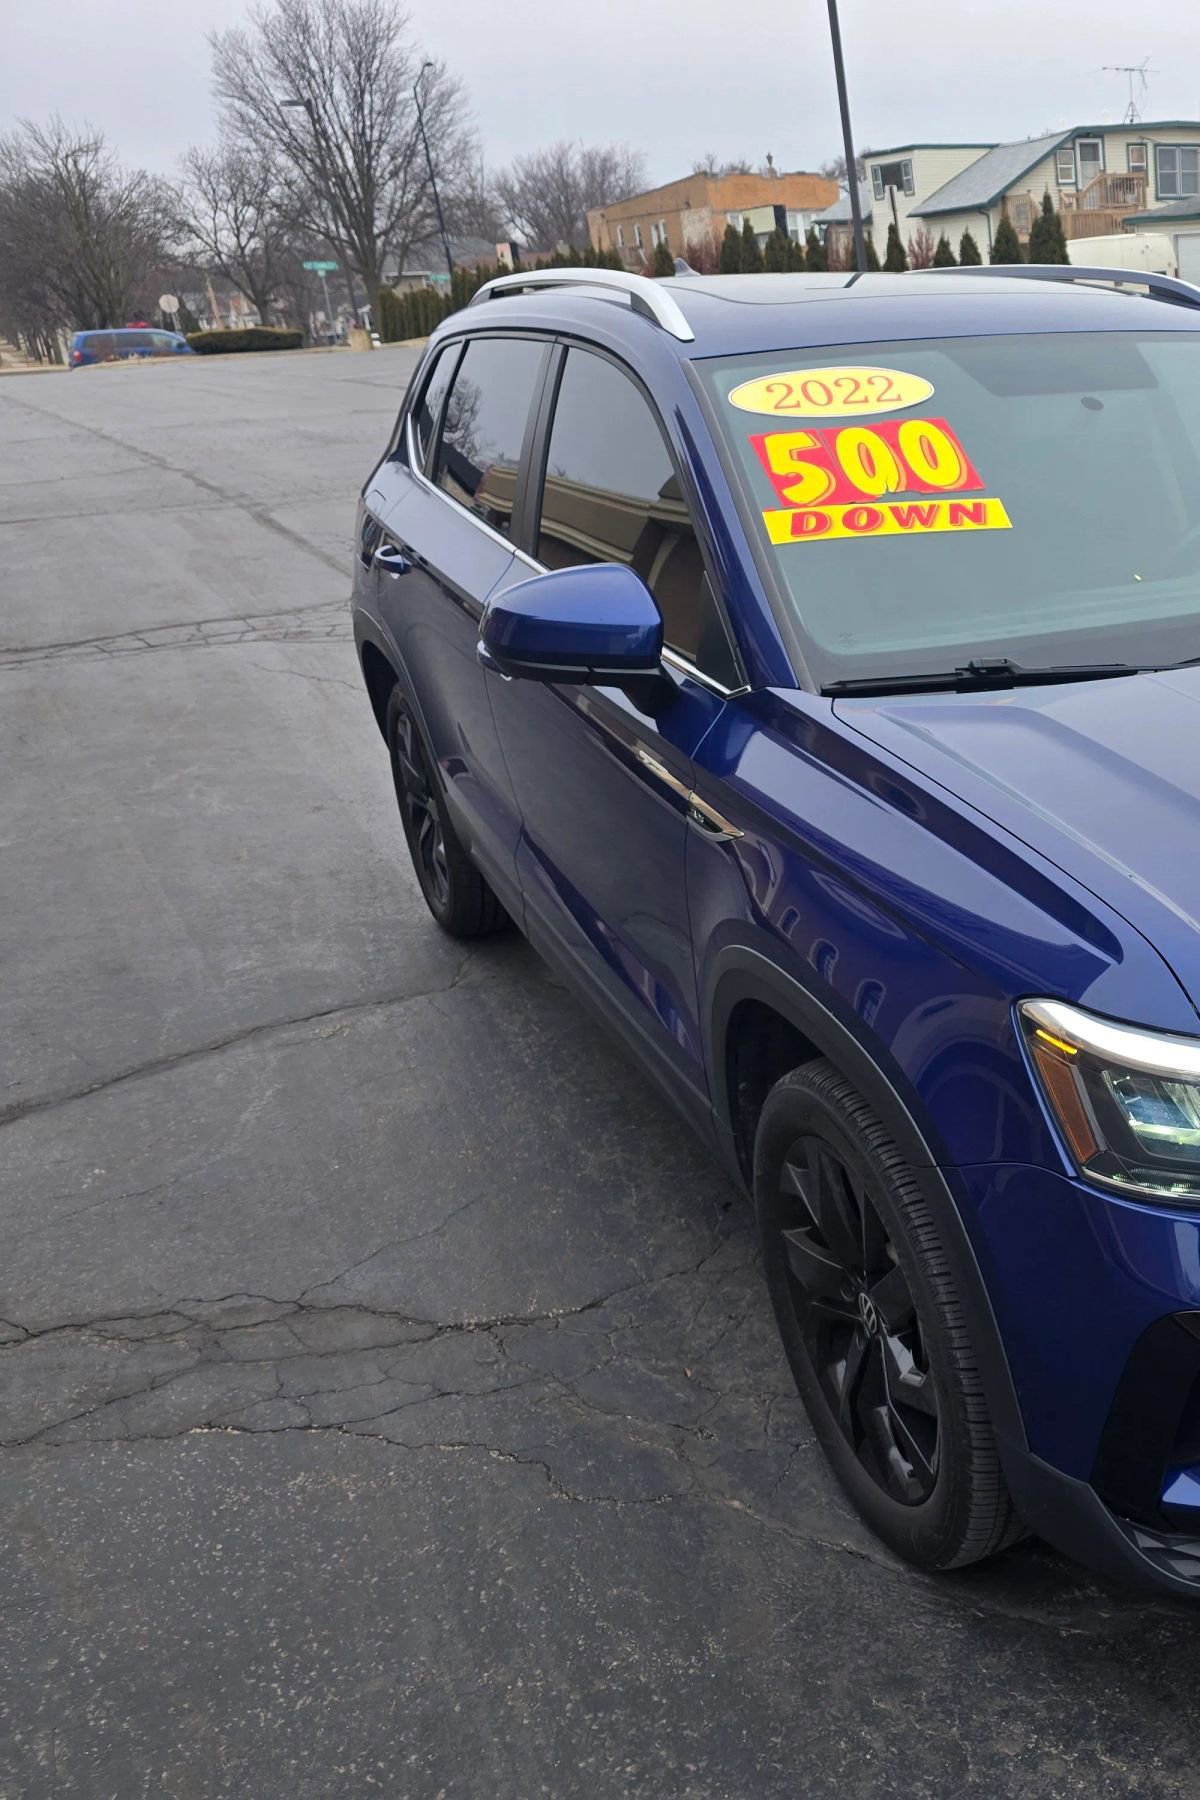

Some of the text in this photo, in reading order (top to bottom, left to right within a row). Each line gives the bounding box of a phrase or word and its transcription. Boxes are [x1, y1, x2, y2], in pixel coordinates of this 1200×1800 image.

[765, 375, 902, 410] 2022
[763, 419, 967, 506] 500
[790, 502, 987, 538] DOWN
